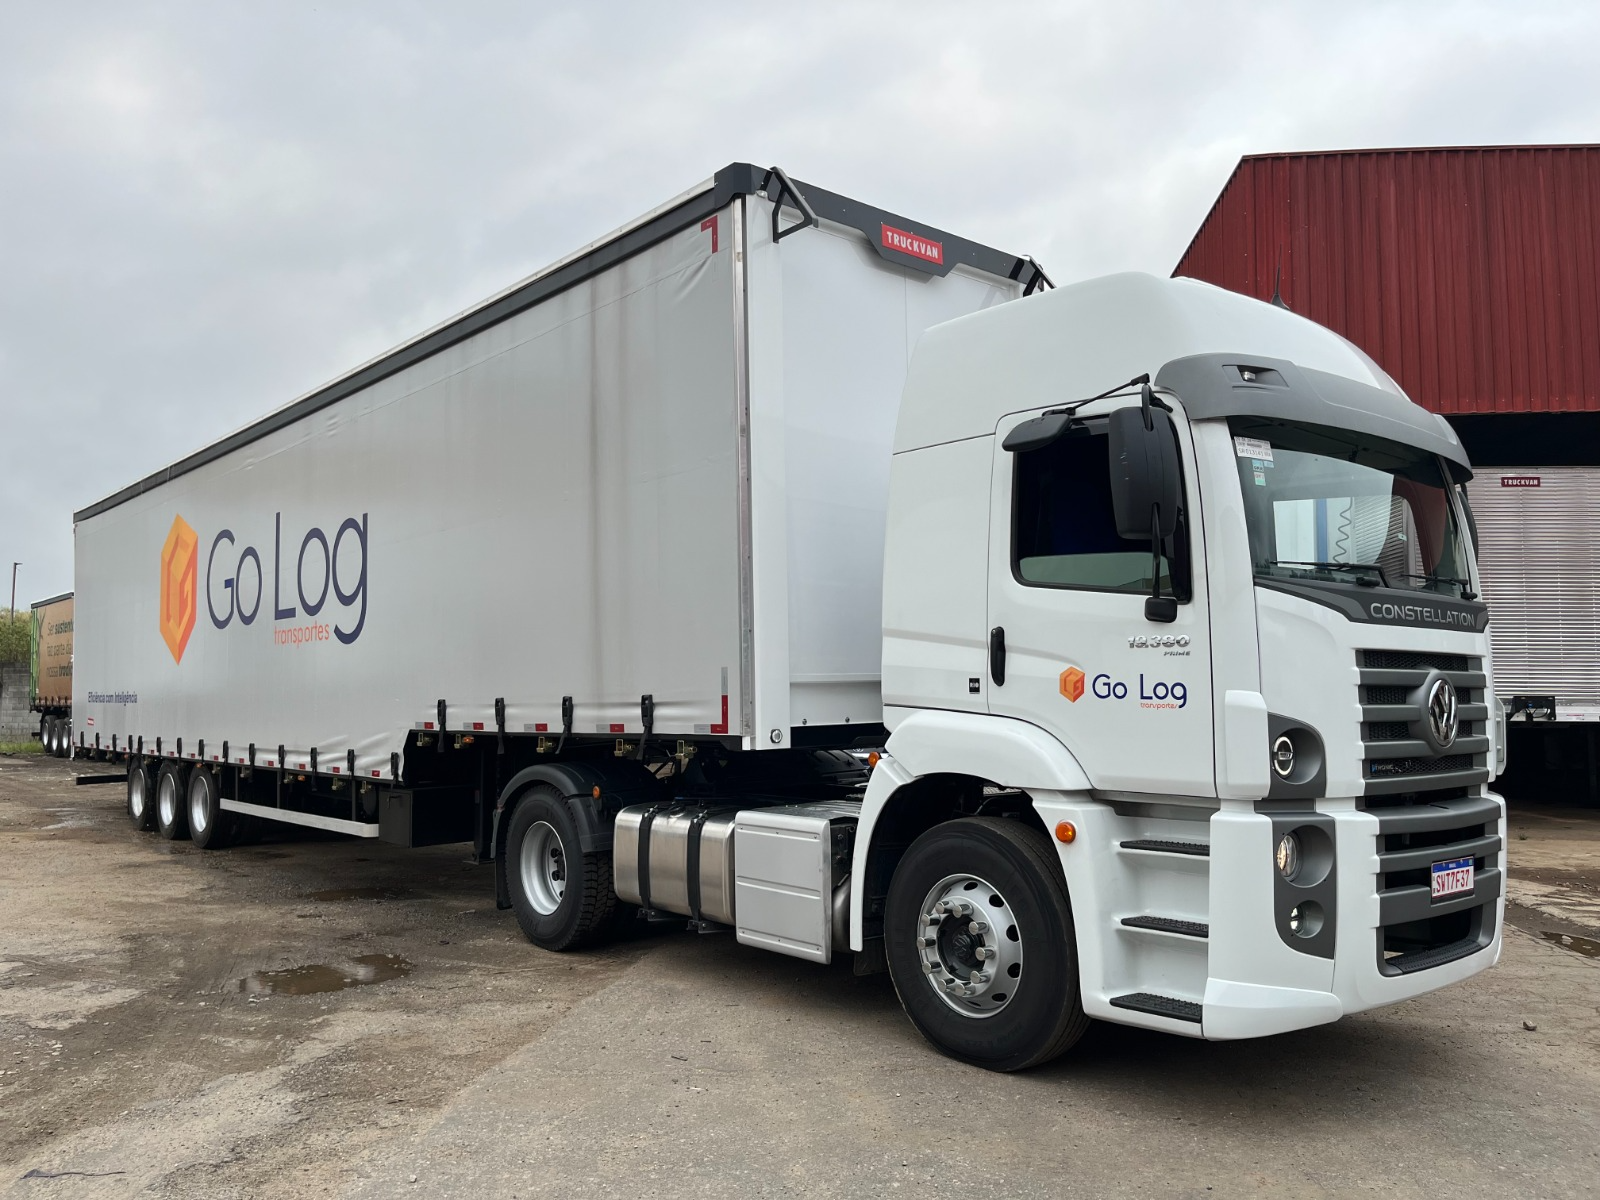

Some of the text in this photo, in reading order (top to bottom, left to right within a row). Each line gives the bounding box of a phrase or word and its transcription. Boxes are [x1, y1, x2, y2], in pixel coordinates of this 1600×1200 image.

[886, 231, 939, 259] TRUCKVAN
[206, 511, 369, 645] Go Log
[1370, 602, 1475, 627] CONSTELLATION
[274, 621, 330, 648] transportes
[105, 694, 114, 703] com
[1092, 673, 1188, 709] Go Log
[1140, 702, 1178, 710] transportes
[1436, 869, 1470, 893] SWT7F37
